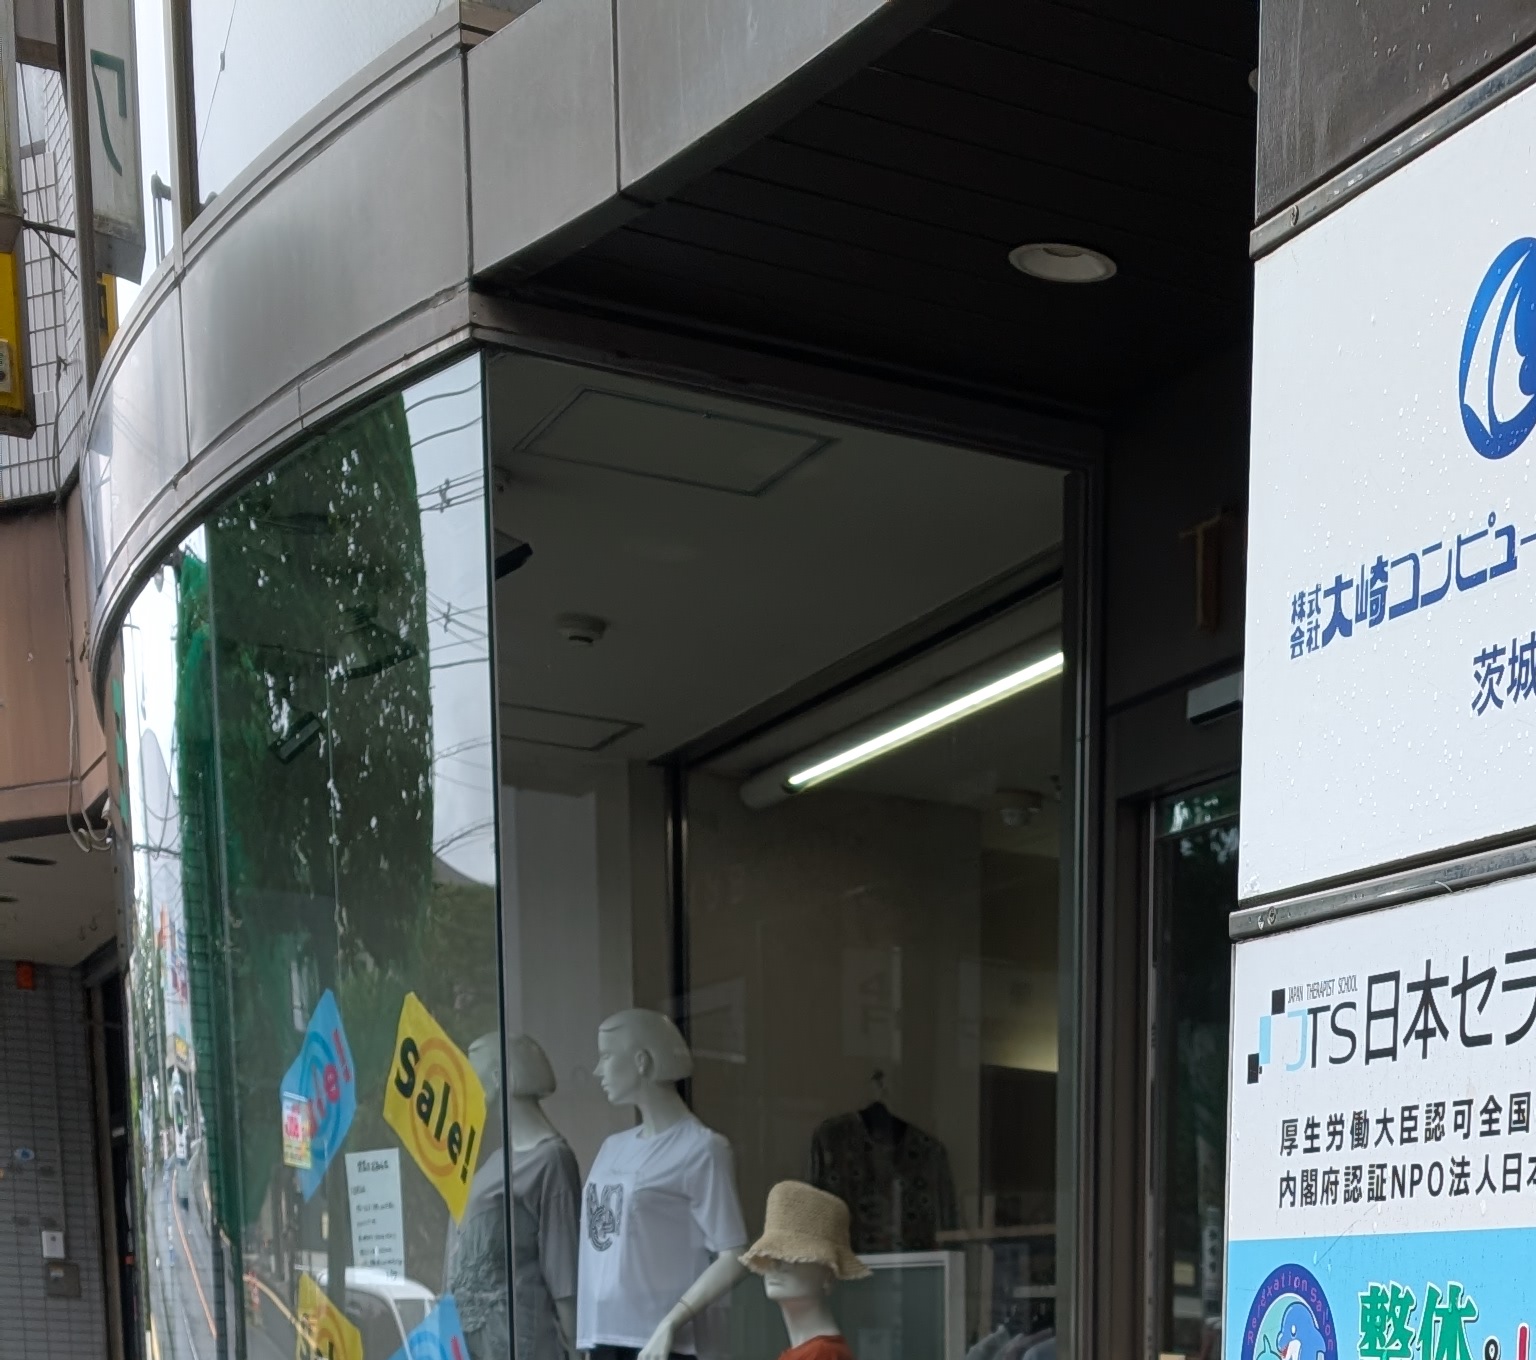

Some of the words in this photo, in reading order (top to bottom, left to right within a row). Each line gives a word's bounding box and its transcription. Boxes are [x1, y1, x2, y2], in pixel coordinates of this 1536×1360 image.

[1288, 986, 1303, 1003] JAPAN
[1307, 979, 1335, 1000] THERAPIST
[1338, 974, 1358, 994] SCHOOL
[394, 1035, 480, 1187] Sale!
